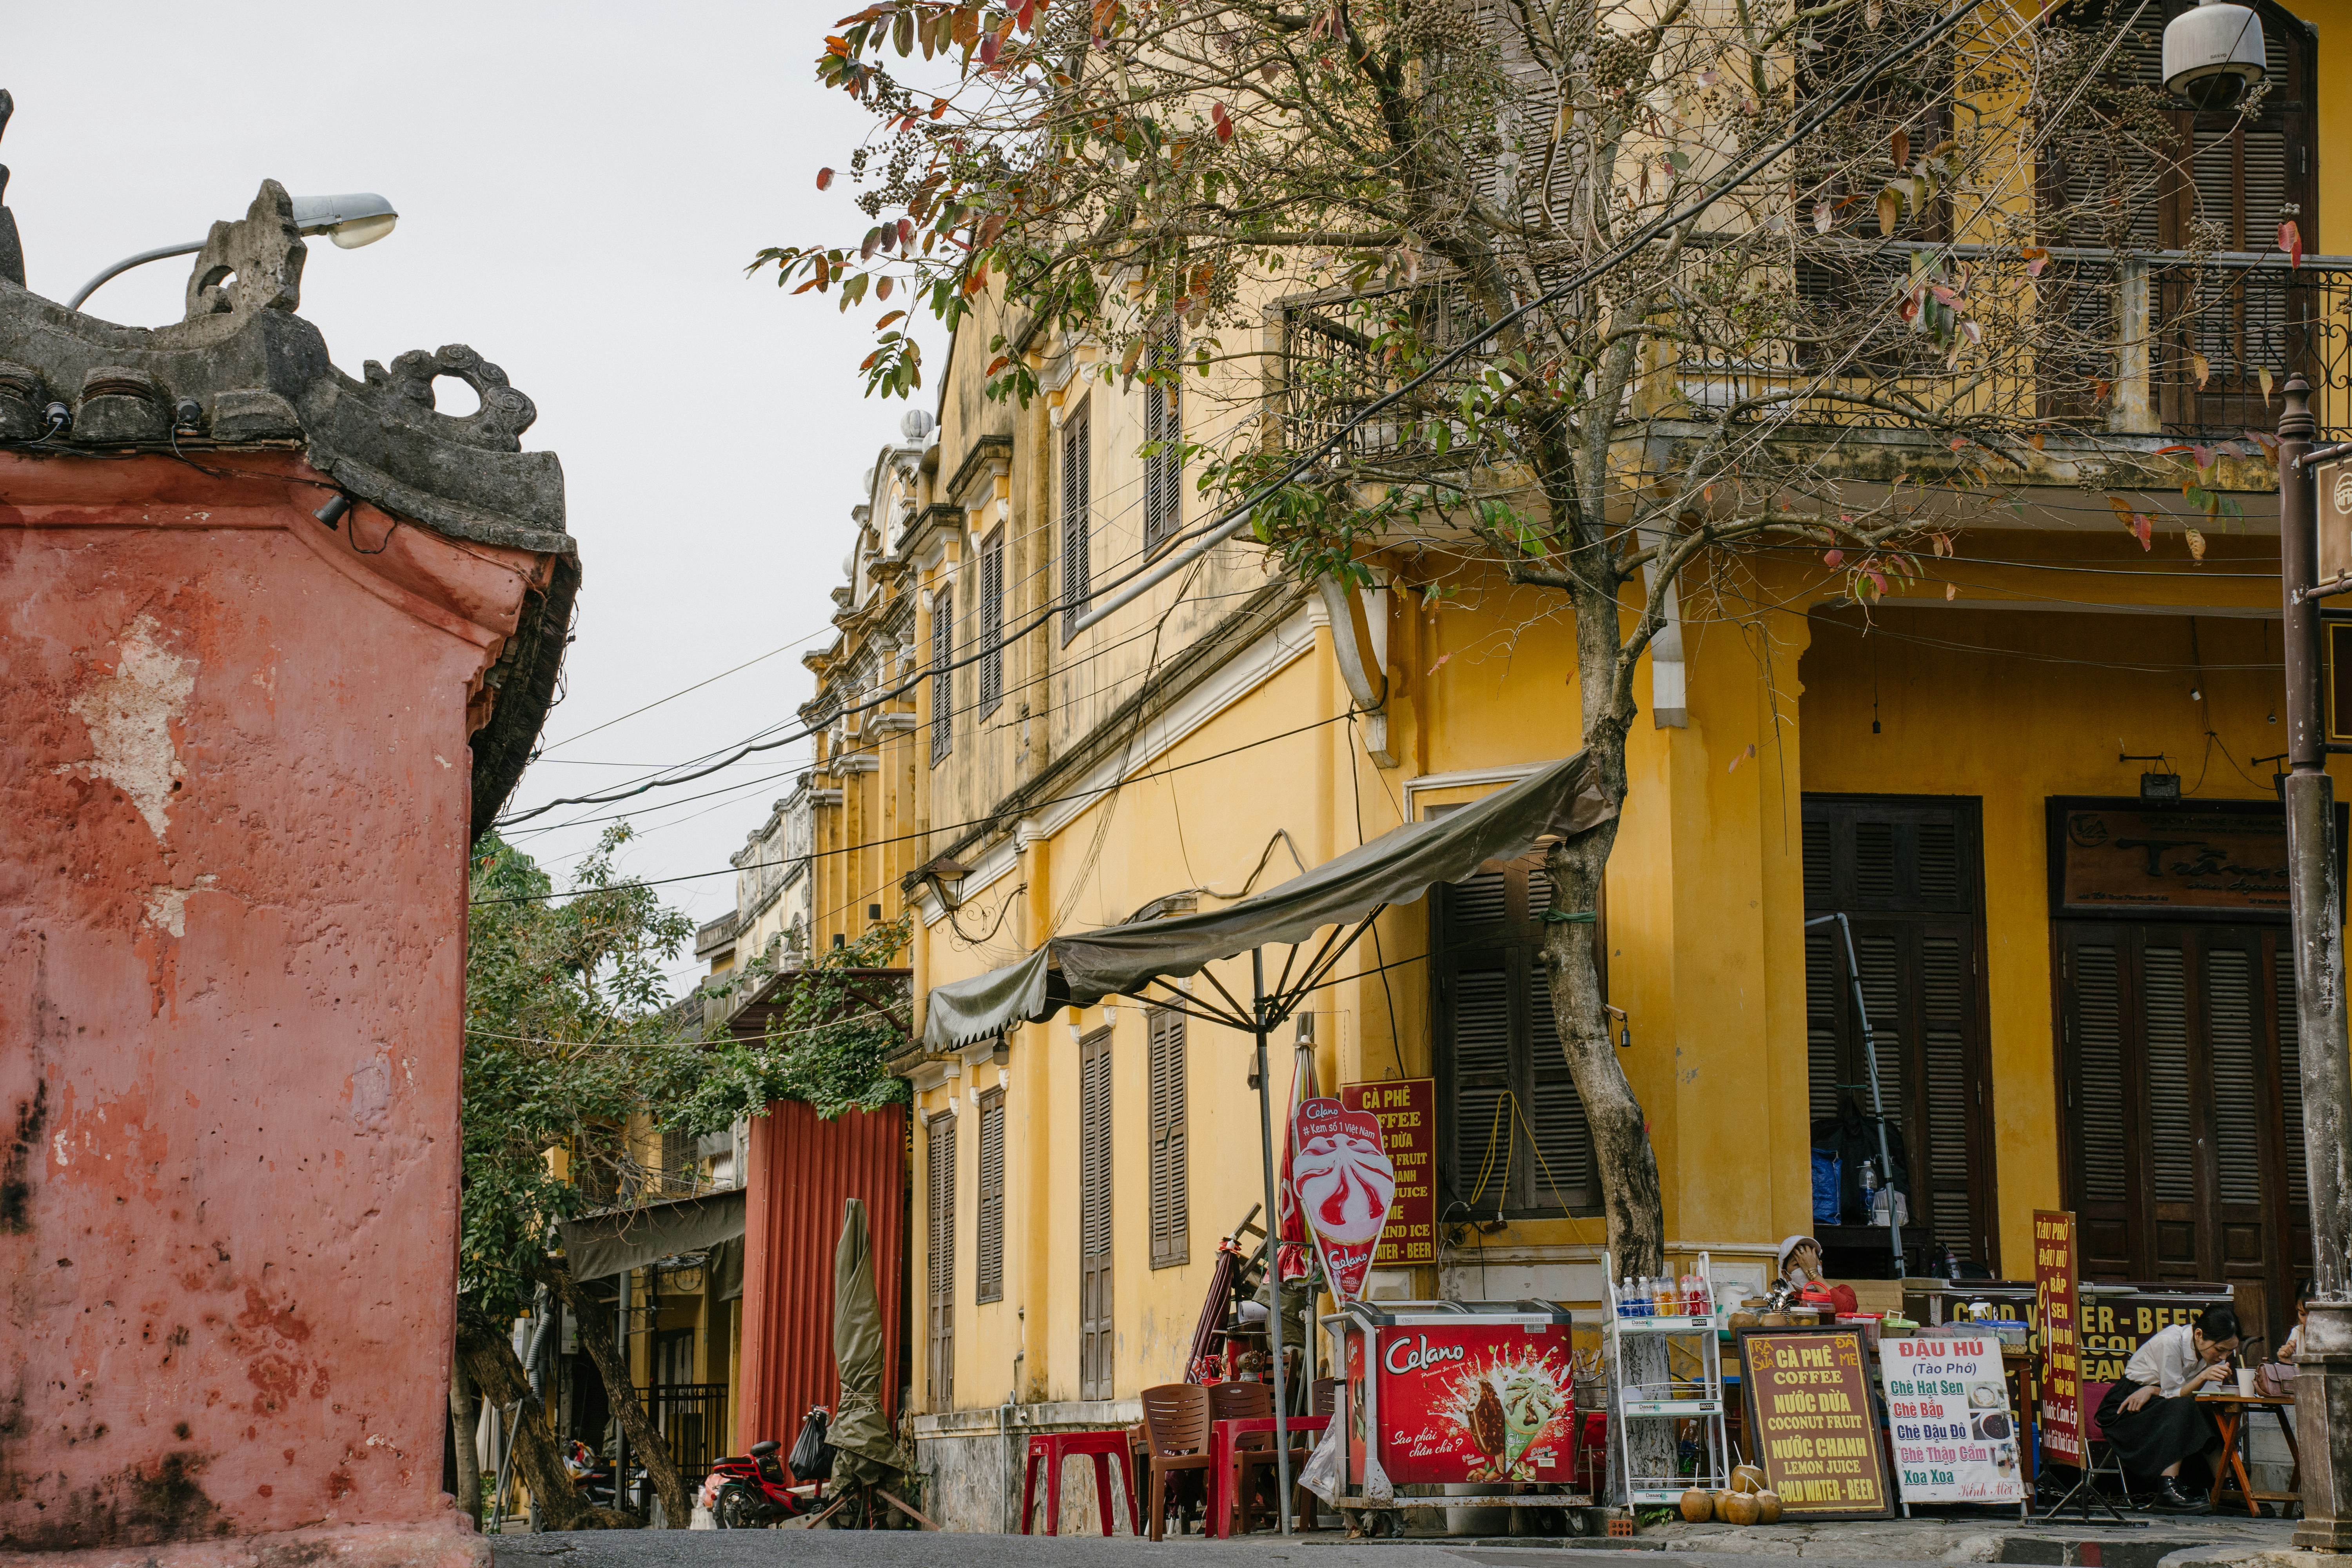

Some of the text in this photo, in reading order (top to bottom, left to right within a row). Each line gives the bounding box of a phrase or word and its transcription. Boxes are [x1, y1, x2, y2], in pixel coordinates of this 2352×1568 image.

[1363, 1085, 1410, 1109] CÀ PHÊ
[1306, 1103, 1338, 1120] Celano
[1376, 1111, 1421, 1129] FFEE
[1310, 1123, 1328, 1134] Kem
[1329, 1121, 1337, 1132] số
[1339, 1122, 1343, 1132] 1
[1345, 1123, 1358, 1135] Việt
[1359, 1125, 1375, 1140] Nam
[1392, 1131, 1413, 1148] DỪA
[1396, 1152, 1427, 1166] FRUIT
[1410, 1224, 1430, 1237] ICE
[2036, 1217, 2068, 1241] TÀU PHỚ
[1327, 1247, 1367, 1270] Celano
[1374, 1243, 1398, 1260] ATER
[1407, 1242, 1431, 1258] BEER
[2039, 1244, 2067, 1270] ĐẬU HỦ
[2050, 1272, 2067, 1293] BẮP
[2051, 1302, 2068, 1319] SEN
[1834, 1333, 1856, 1348] ĐÁ
[2052, 1325, 2063, 1347] ĐẬU
[2064, 1325, 2073, 1345] ĐỎ
[1384, 1334, 1465, 1376] Celano
[1775, 1345, 1834, 1368] CÀ PHÊ
[1898, 1337, 1984, 1360] ĐẬU HỦ
[1839, 1353, 1858, 1366] ME
[1913, 1362, 1976, 1376] (Tào Phớ)
[2053, 1350, 2062, 1372] ĐẬU
[2062, 1349, 2075, 1371] TRẮNG
[1421, 1362, 1465, 1378] Premium Ice-cream
[1773, 1370, 1843, 1385] COFFEE
[1891, 1380, 1965, 1398] Chè Hạt Sen
[2054, 1376, 2065, 1398] THẬP
[2065, 1374, 2075, 1397] CẨM
[1773, 1389, 1851, 1414] NƯỚC DỪA
[1893, 1399, 1944, 1419] Chè Bắp
[1768, 1415, 1862, 1431] COCONUT FRUIT
[2043, 1399, 2056, 1420] Nước
[2056, 1402, 2069, 1423] Cam
[2070, 1400, 2077, 1429] Ép
[1391, 1427, 1437, 1447] Sao phải
[1507, 1433, 1528, 1444] Celano
[1897, 1422, 1967, 1442] Chè Đậu Đỏ
[1409, 1442, 1433, 1457] chần
[1771, 1434, 1868, 1459] NƯỚC CHANH
[1900, 1443, 1988, 1464] Chè Thập Cẩm
[1783, 1460, 1861, 1475] LEMON JUICE
[1903, 1469, 1955, 1485] Xoa Xoa
[1777, 1480, 1804, 1503] COLD
[1804, 1479, 1841, 1501] WATER
[1846, 1479, 1875, 1500] BEER
[1958, 1483, 1986, 1497] Kính
[1990, 1482, 2013, 1496] Mời
